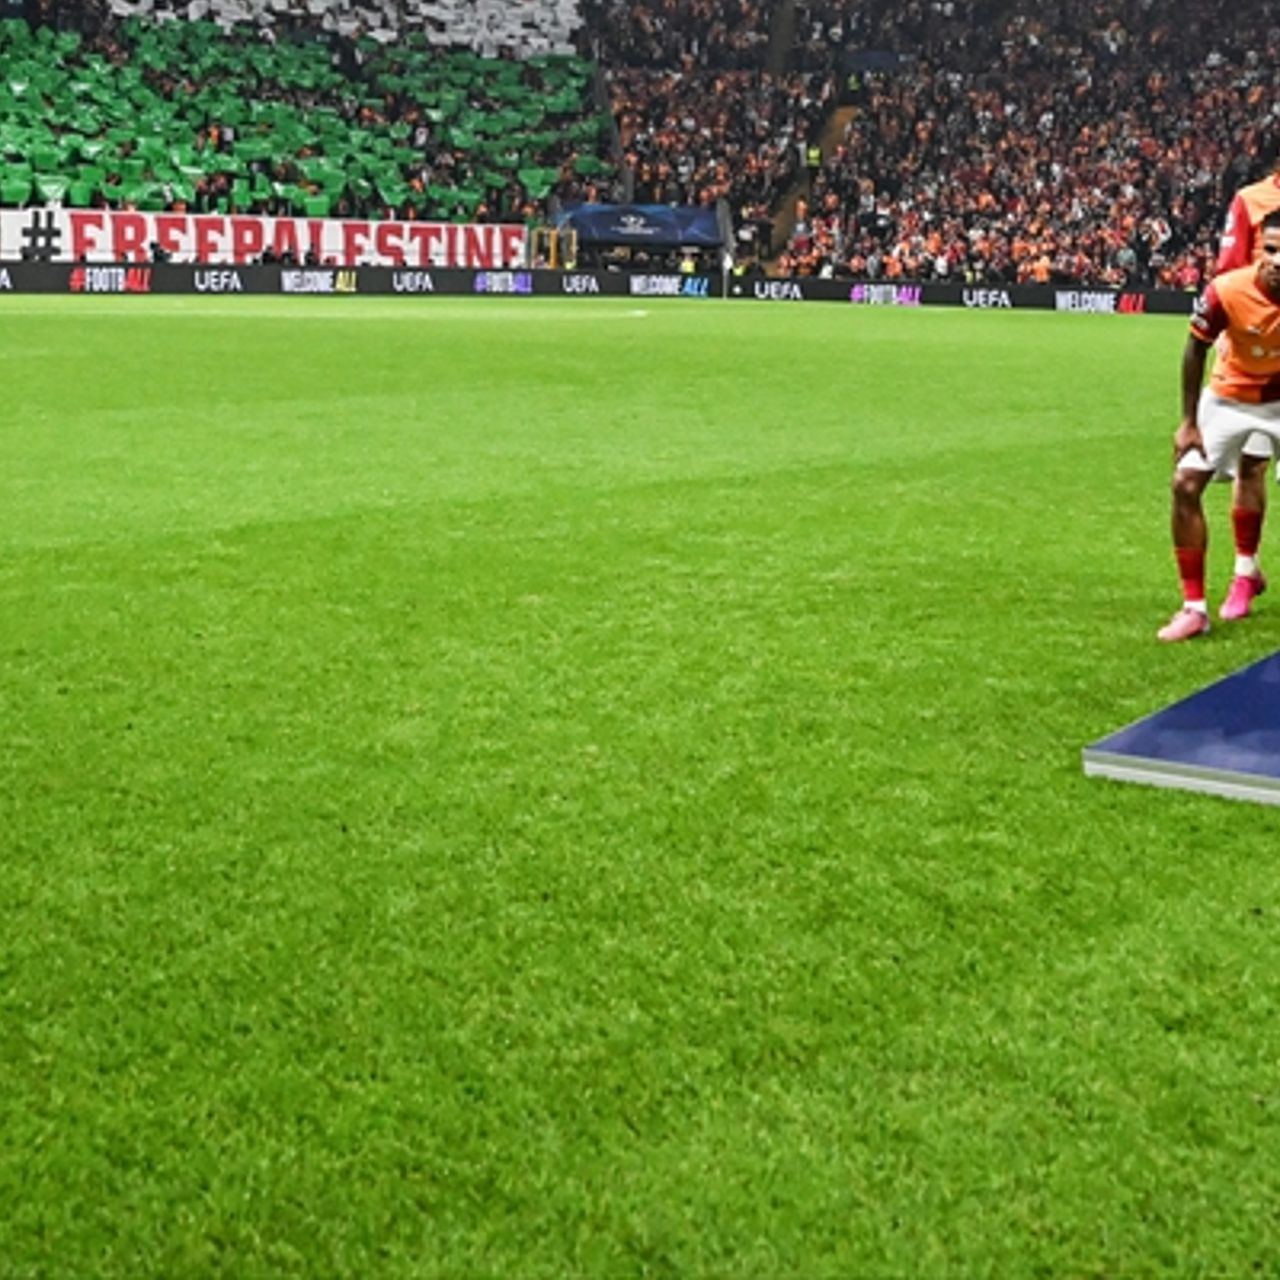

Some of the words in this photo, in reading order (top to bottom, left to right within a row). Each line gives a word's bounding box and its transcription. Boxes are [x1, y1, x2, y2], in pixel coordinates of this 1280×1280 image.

[21, 211, 527, 267] #FREEPALESTINE
[194, 271, 241, 292] UEFA
[281, 270, 336, 292] WELCOME
[335, 271, 357, 292] ALL
[393, 273, 433, 292] UEFA
[563, 276, 599, 294] UEFA
[630, 275, 682, 295] WELCOME
[682, 276, 709, 296] ALL
[755, 281, 802, 300] UEFA
[963, 289, 1012, 308] UEFA
[1055, 290, 1118, 313] WELCOME
[1118, 293, 1146, 314] ALL
